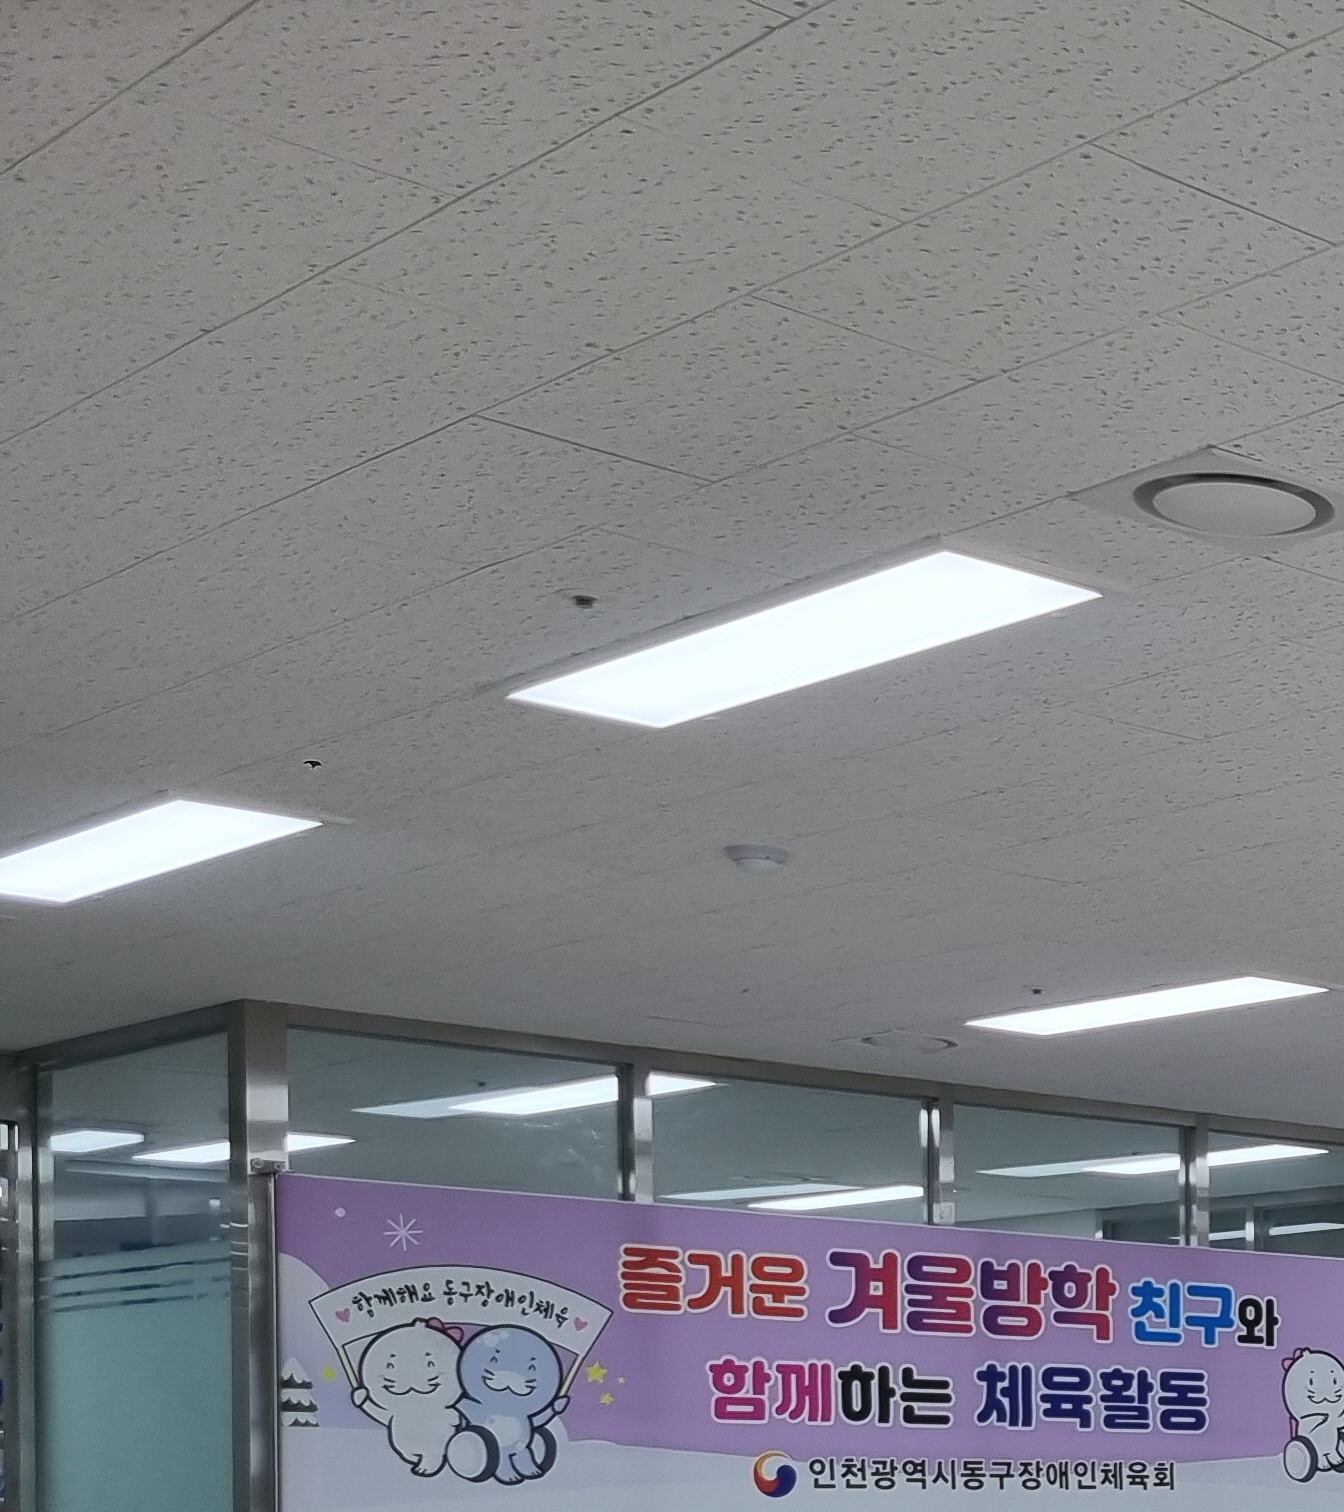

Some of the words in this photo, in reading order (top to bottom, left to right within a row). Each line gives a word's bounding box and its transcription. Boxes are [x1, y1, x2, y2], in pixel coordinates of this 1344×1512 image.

[351, 1282, 436, 1318] 함께해요
[443, 1279, 569, 1328] 동구장애인체육
[620, 1244, 808, 1320] 즐거운
[825, 1249, 1119, 1343] 겨울방학
[1129, 1278, 1281, 1349] 친구와
[707, 1356, 953, 1429] 함께하는
[974, 1362, 1210, 1434] 체육활동
[808, 1457, 1176, 1491] 인천광역시동구장애인체육회
